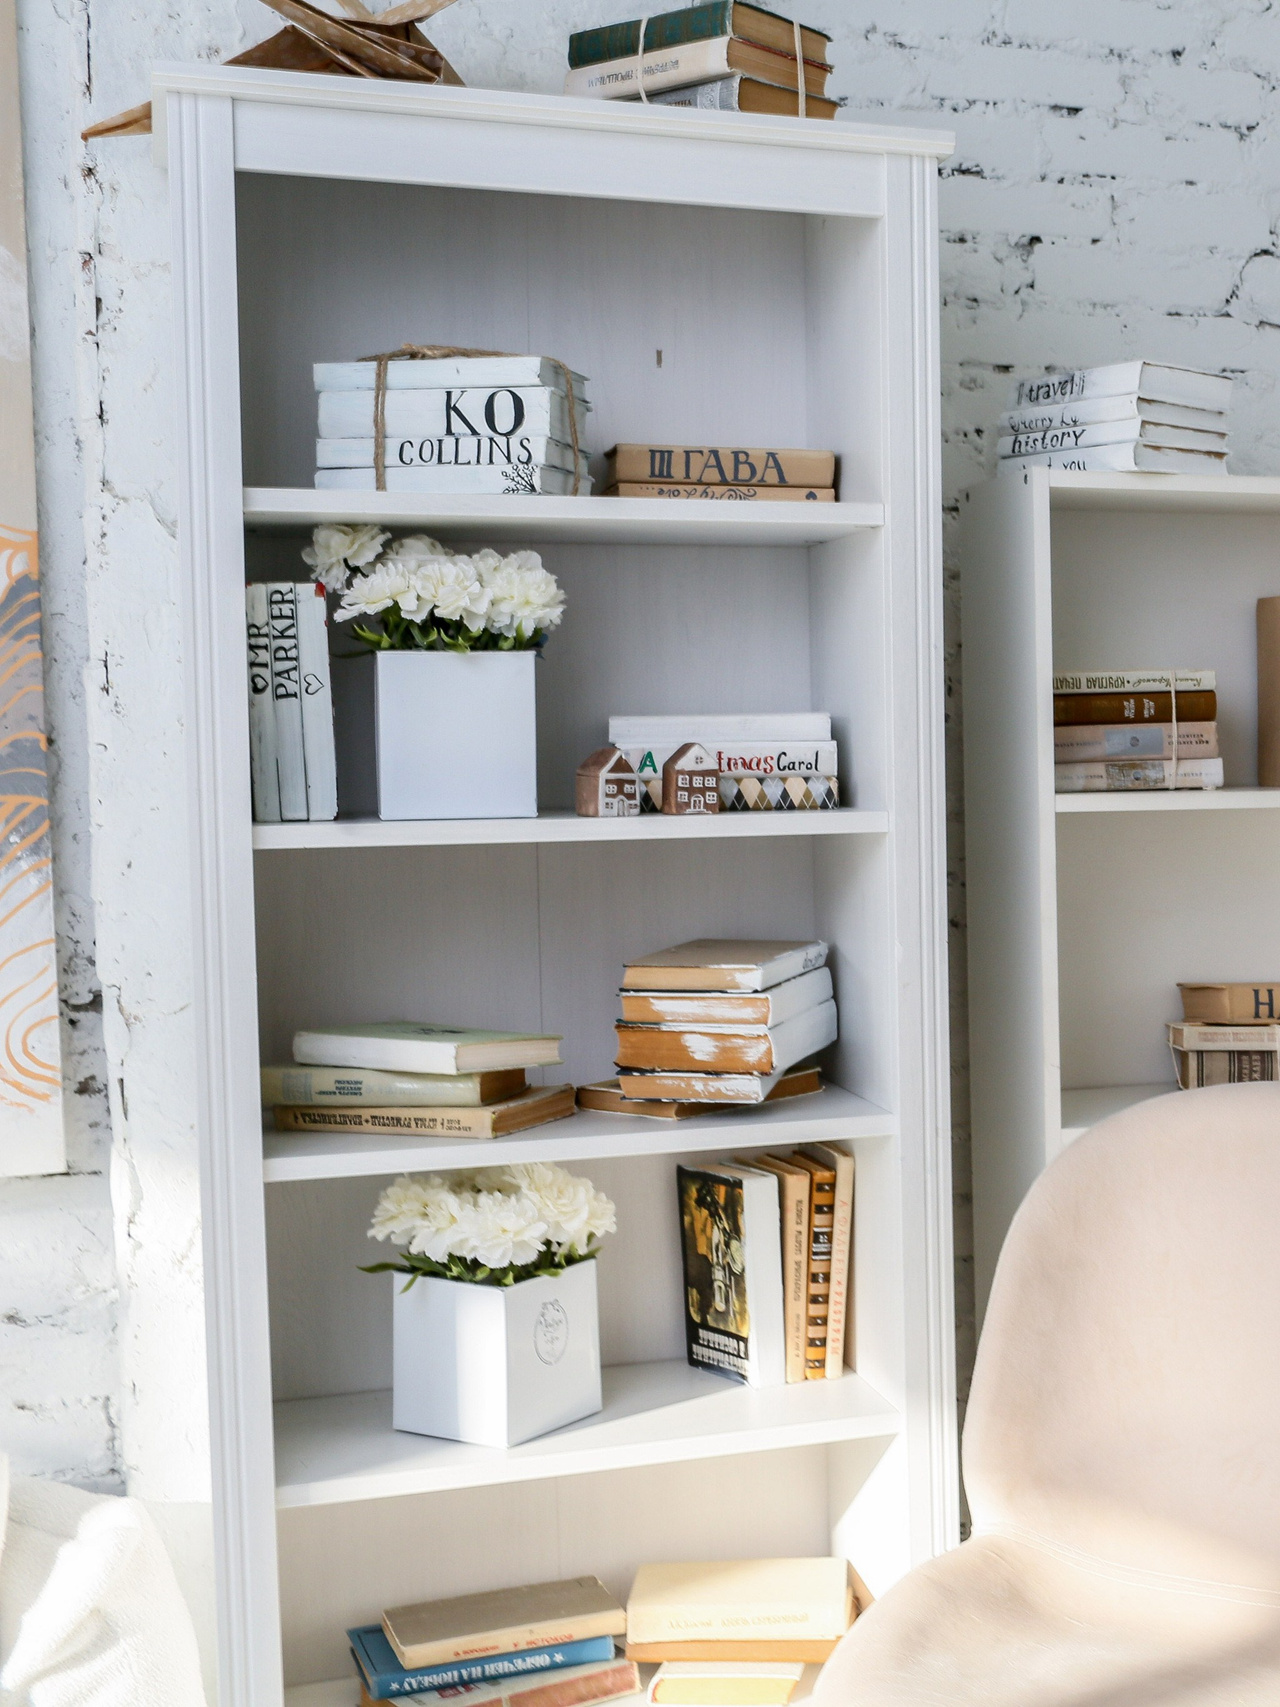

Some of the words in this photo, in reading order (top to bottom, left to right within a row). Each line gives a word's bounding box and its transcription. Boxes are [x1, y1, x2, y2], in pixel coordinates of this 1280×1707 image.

[1028, 374, 1076, 403] travel
[444, 389, 526, 437] KO
[398, 437, 533, 466] COLLINS
[683, 449, 789, 484] ГАВА
[247, 621, 269, 669] MR
[269, 587, 298, 701] PARKER
[1085, 676, 1126, 690] КРУГЛАЯ
[637, 750, 658, 774] A
[776, 750, 820, 772] Carol
[402, 1670, 459, 1692] ПОБЕДУ
[460, 1666, 483, 1681] НА
